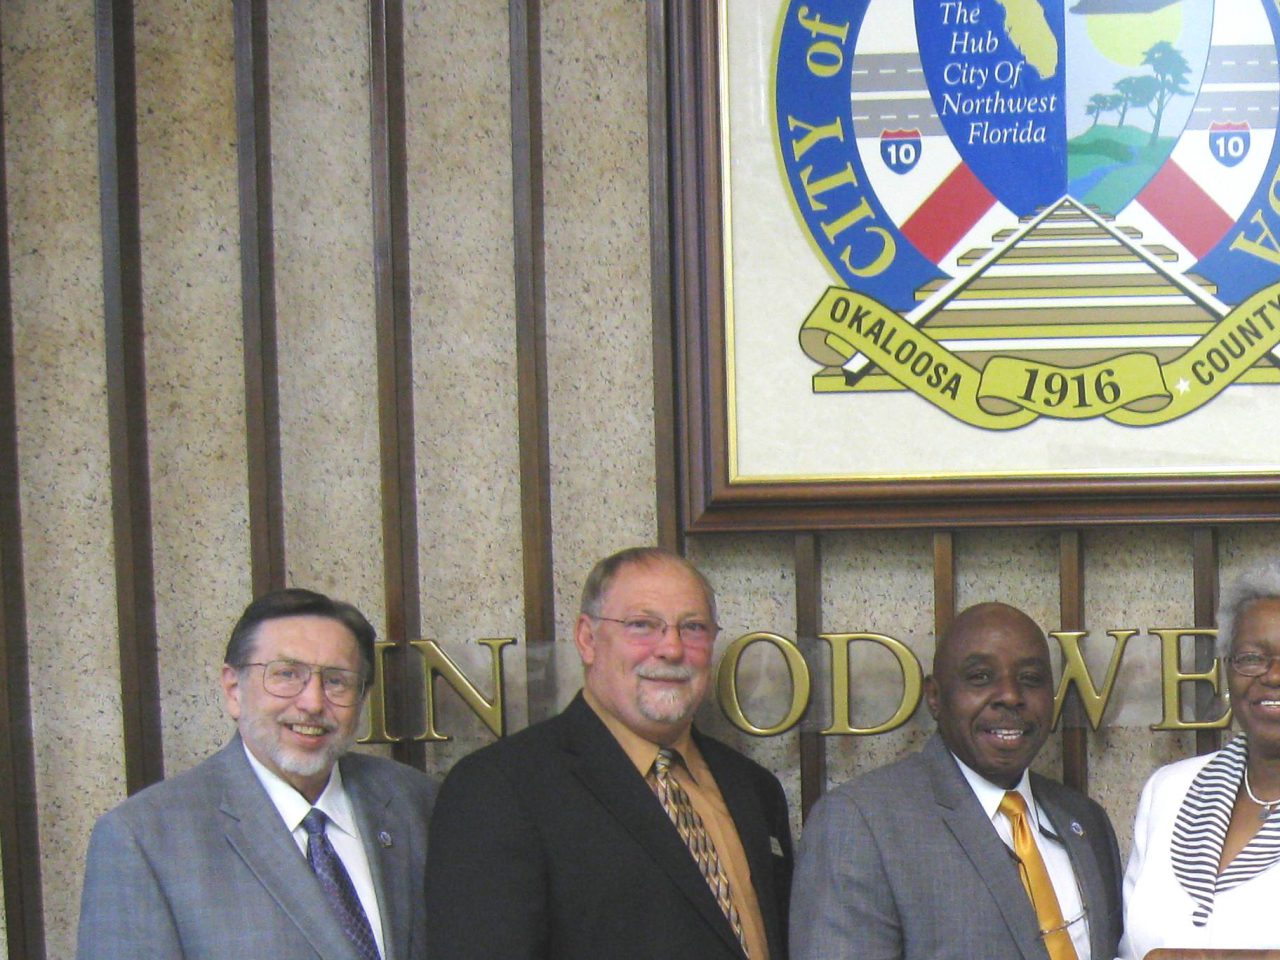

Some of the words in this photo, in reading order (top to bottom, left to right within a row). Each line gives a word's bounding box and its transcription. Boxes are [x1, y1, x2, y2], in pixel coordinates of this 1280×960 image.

[940, 2, 980, 25] The
[797, 5, 850, 78] of
[951, 31, 999, 54] Hub
[943, 62, 990, 90] City
[994, 61, 1025, 88] Of
[941, 92, 1057, 117] Northwest
[968, 121, 1047, 146] Florida
[887, 142, 917, 167] 10
[1215, 136, 1245, 159] 10
[787, 115, 897, 279] CITY
[830, 297, 961, 400] OKALOOSA
[1017, 367, 1123, 409] 1916
[356, 637, 518, 744] IN
[717, 631, 923, 736] OD
